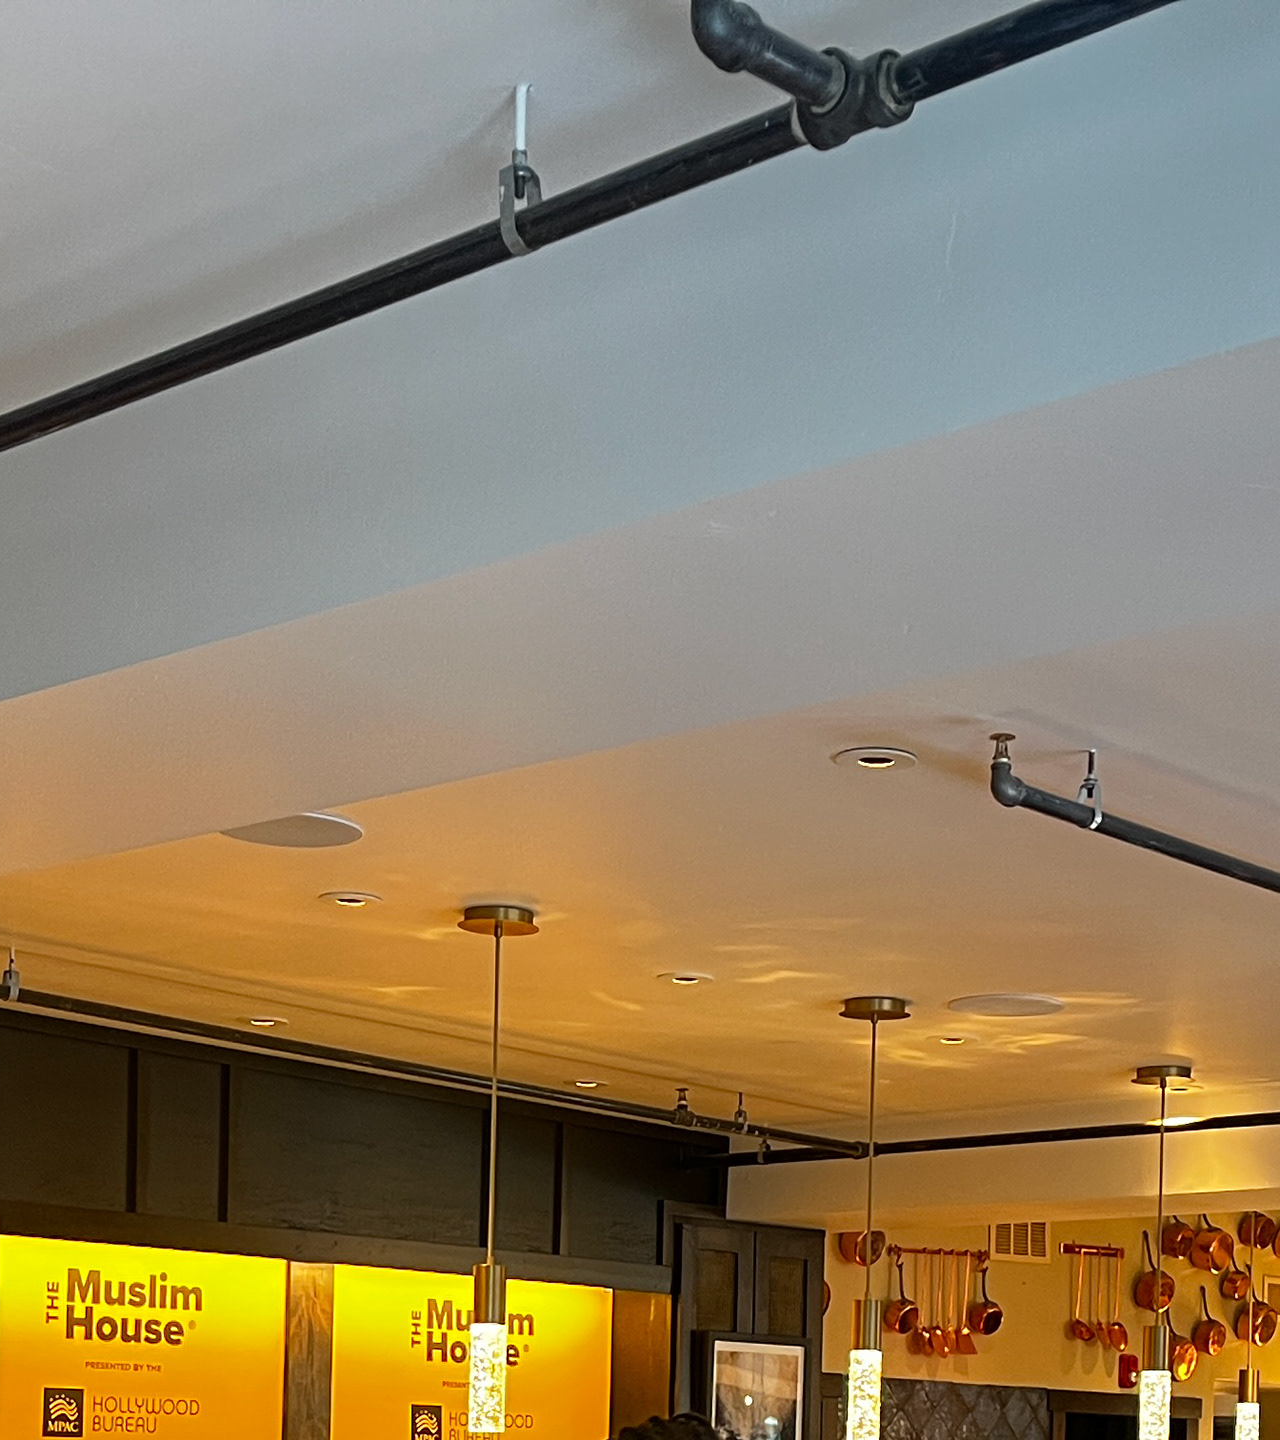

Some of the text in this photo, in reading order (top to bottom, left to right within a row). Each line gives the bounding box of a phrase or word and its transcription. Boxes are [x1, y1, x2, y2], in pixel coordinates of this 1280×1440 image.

[45, 1281, 60, 1324] THE
[66, 1268, 203, 1311] Muslim
[411, 1310, 422, 1348] THE
[427, 1298, 534, 1336] Mum
[426, 1331, 520, 1367] Hoe
[85, 1361, 162, 1372] PRESENTED BY THE
[92, 1396, 200, 1416] HOLLYWOOD
[47, 1420, 80, 1433] MPAC
[92, 1415, 157, 1434] BUREAU
[448, 1411, 535, 1430] HOOOD
